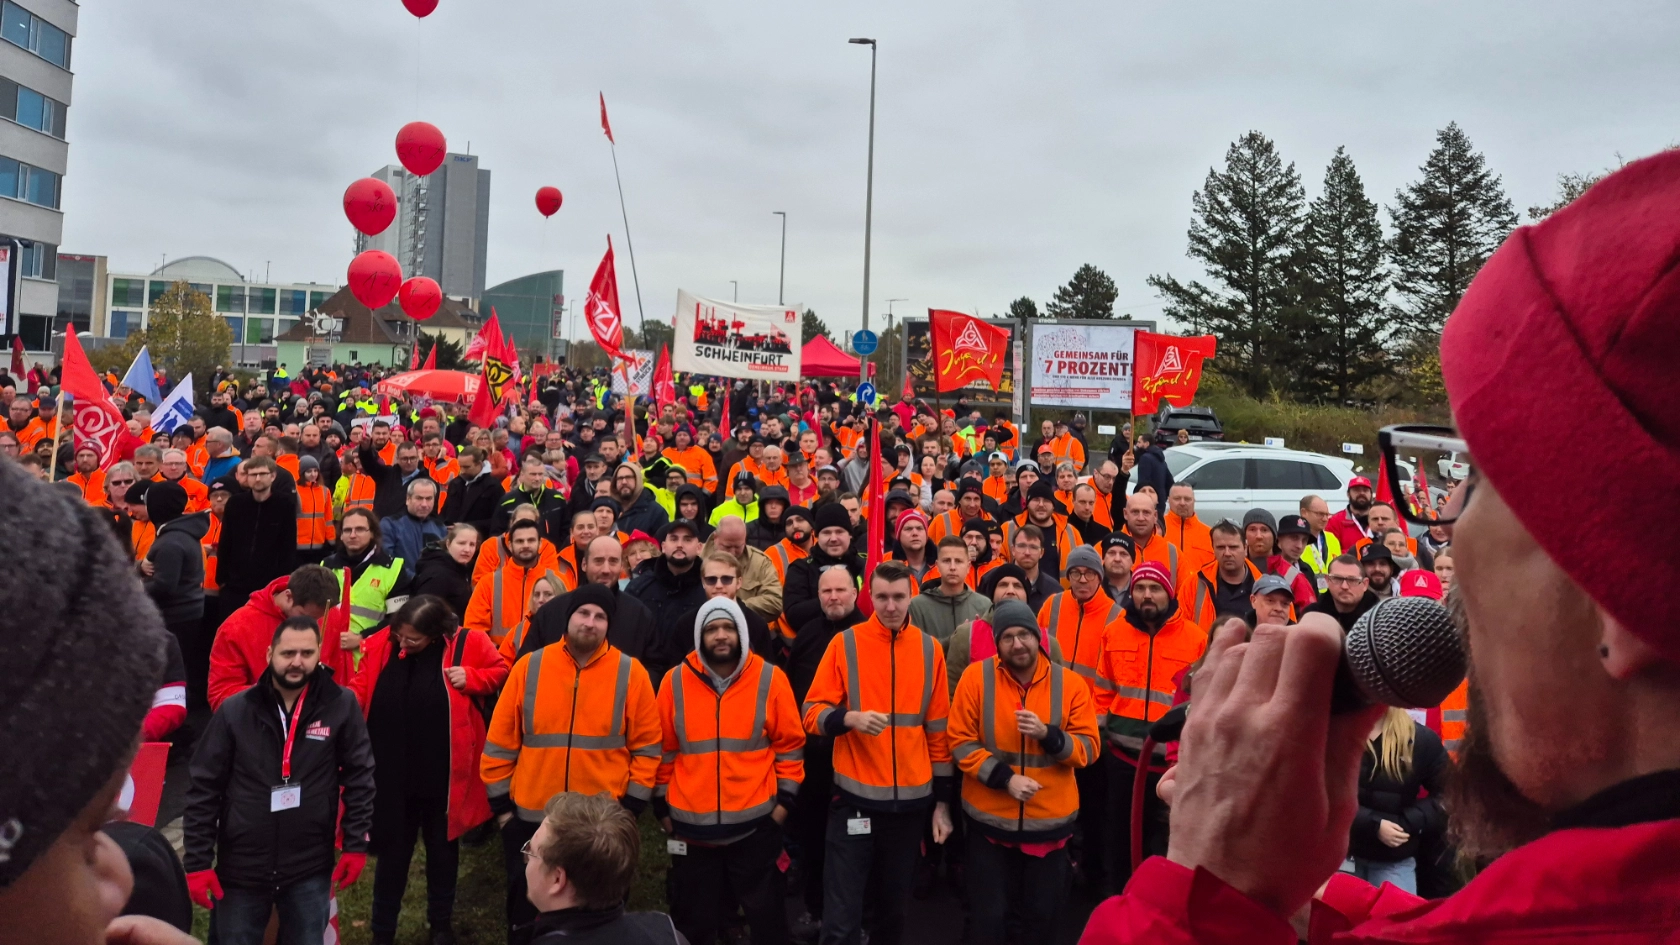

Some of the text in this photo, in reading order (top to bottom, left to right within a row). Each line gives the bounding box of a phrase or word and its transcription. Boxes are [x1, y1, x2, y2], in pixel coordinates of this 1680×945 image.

[454, 155, 473, 163] SKF
[695, 345, 784, 365] SCHWEINFURT
[1054, 349, 1129, 361] GEMEINSAM FÜR
[1044, 359, 1133, 377] 7 PROZENT!
